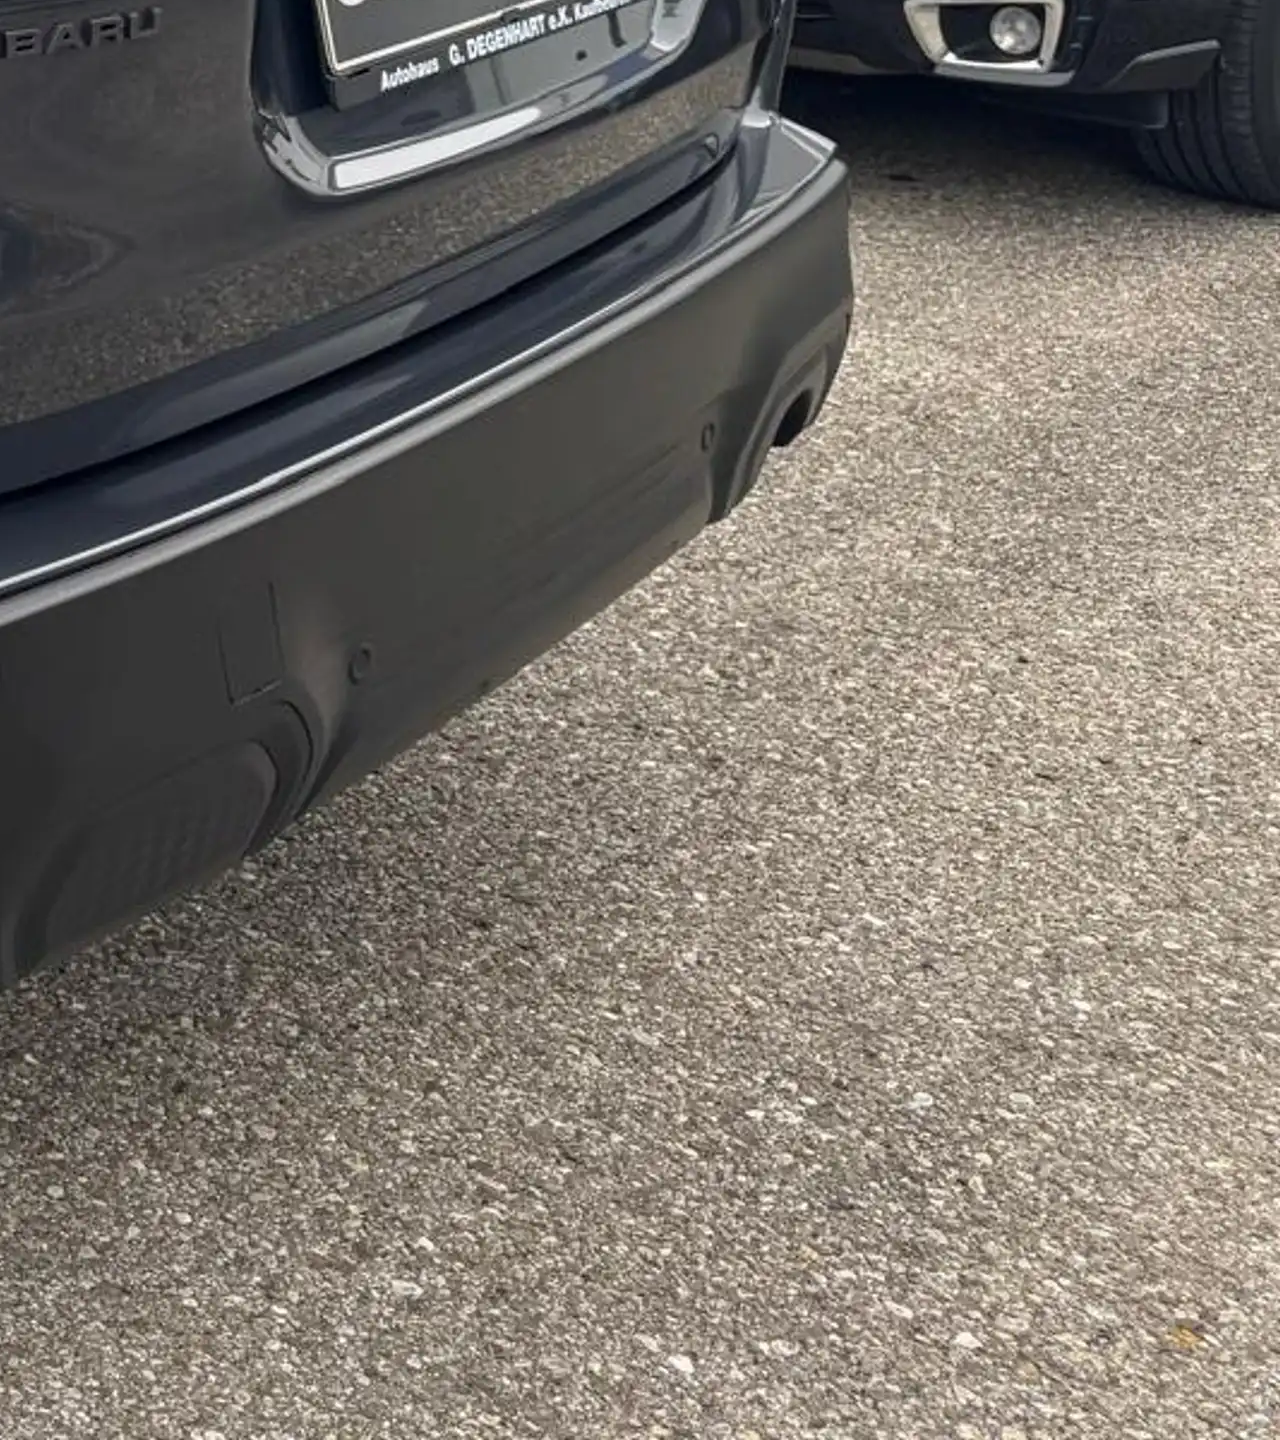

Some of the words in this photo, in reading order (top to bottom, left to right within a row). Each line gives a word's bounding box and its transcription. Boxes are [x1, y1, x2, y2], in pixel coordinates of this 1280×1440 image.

[380, 57, 440, 92] Autohaus
[448, 43, 465, 66] G.
[466, 14, 547, 60] DEGENHART
